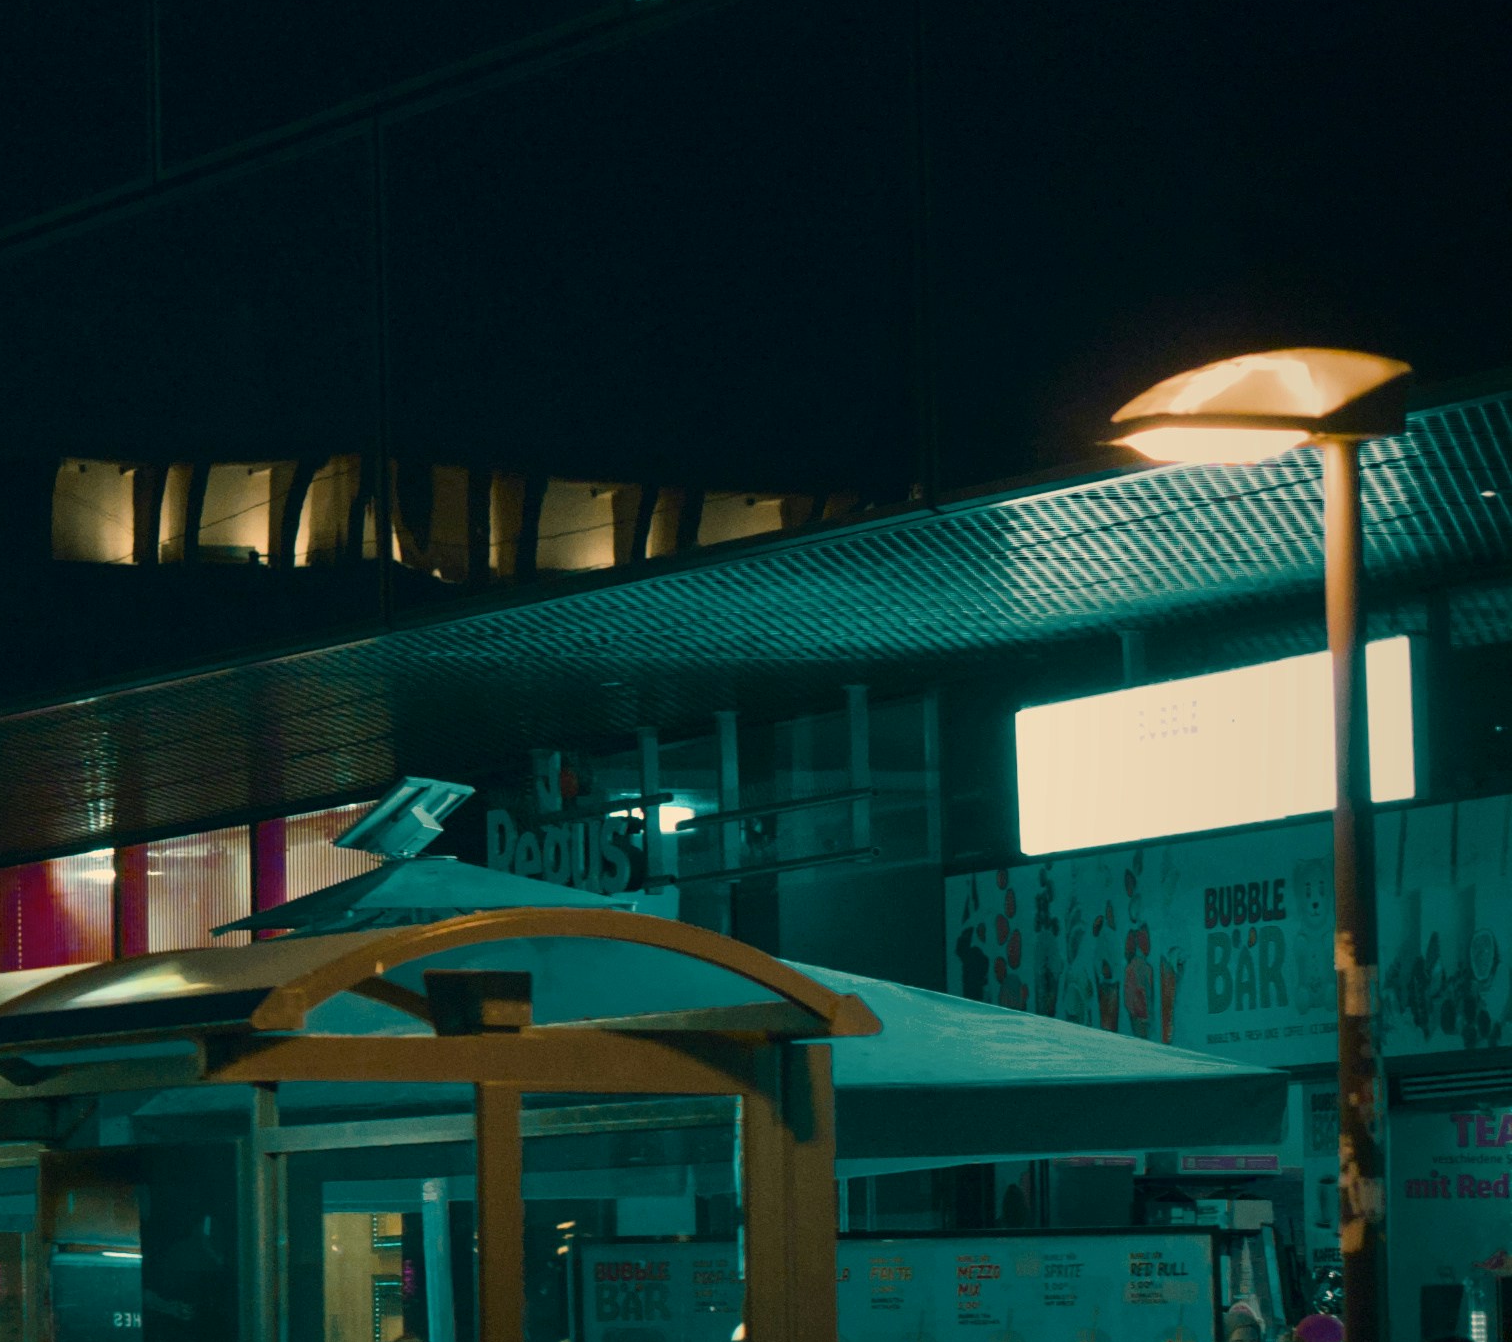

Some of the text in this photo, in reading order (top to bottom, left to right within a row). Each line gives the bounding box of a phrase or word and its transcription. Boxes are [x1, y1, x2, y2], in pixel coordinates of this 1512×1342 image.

[1204, 878, 1287, 929] BUBBLE
[1206, 925, 1289, 1015] BÄR
[1405, 1171, 1510, 1199] mit Red
